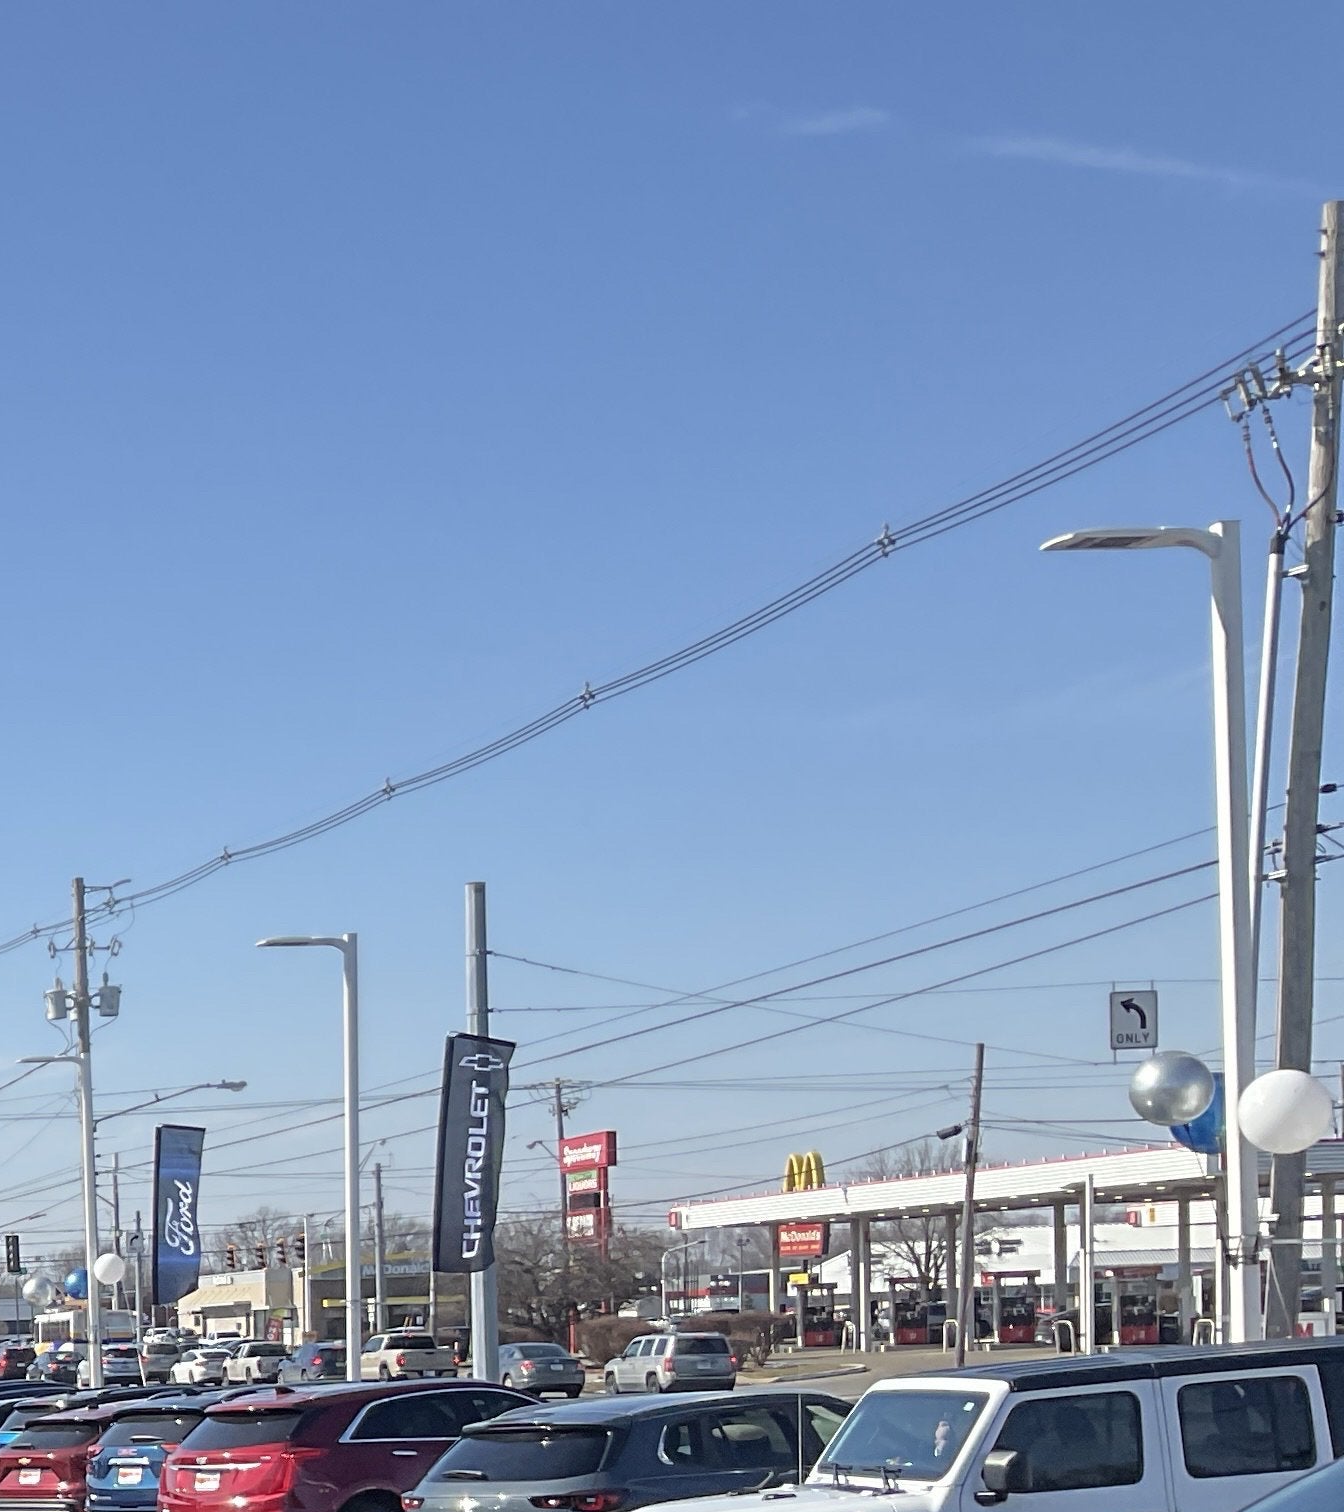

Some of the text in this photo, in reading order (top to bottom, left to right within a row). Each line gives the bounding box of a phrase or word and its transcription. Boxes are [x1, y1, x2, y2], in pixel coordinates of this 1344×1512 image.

[1116, 1032, 1150, 1044] ONLY
[462, 1080, 490, 1259] CHEVROLET
[165, 1179, 194, 1256] Ford
